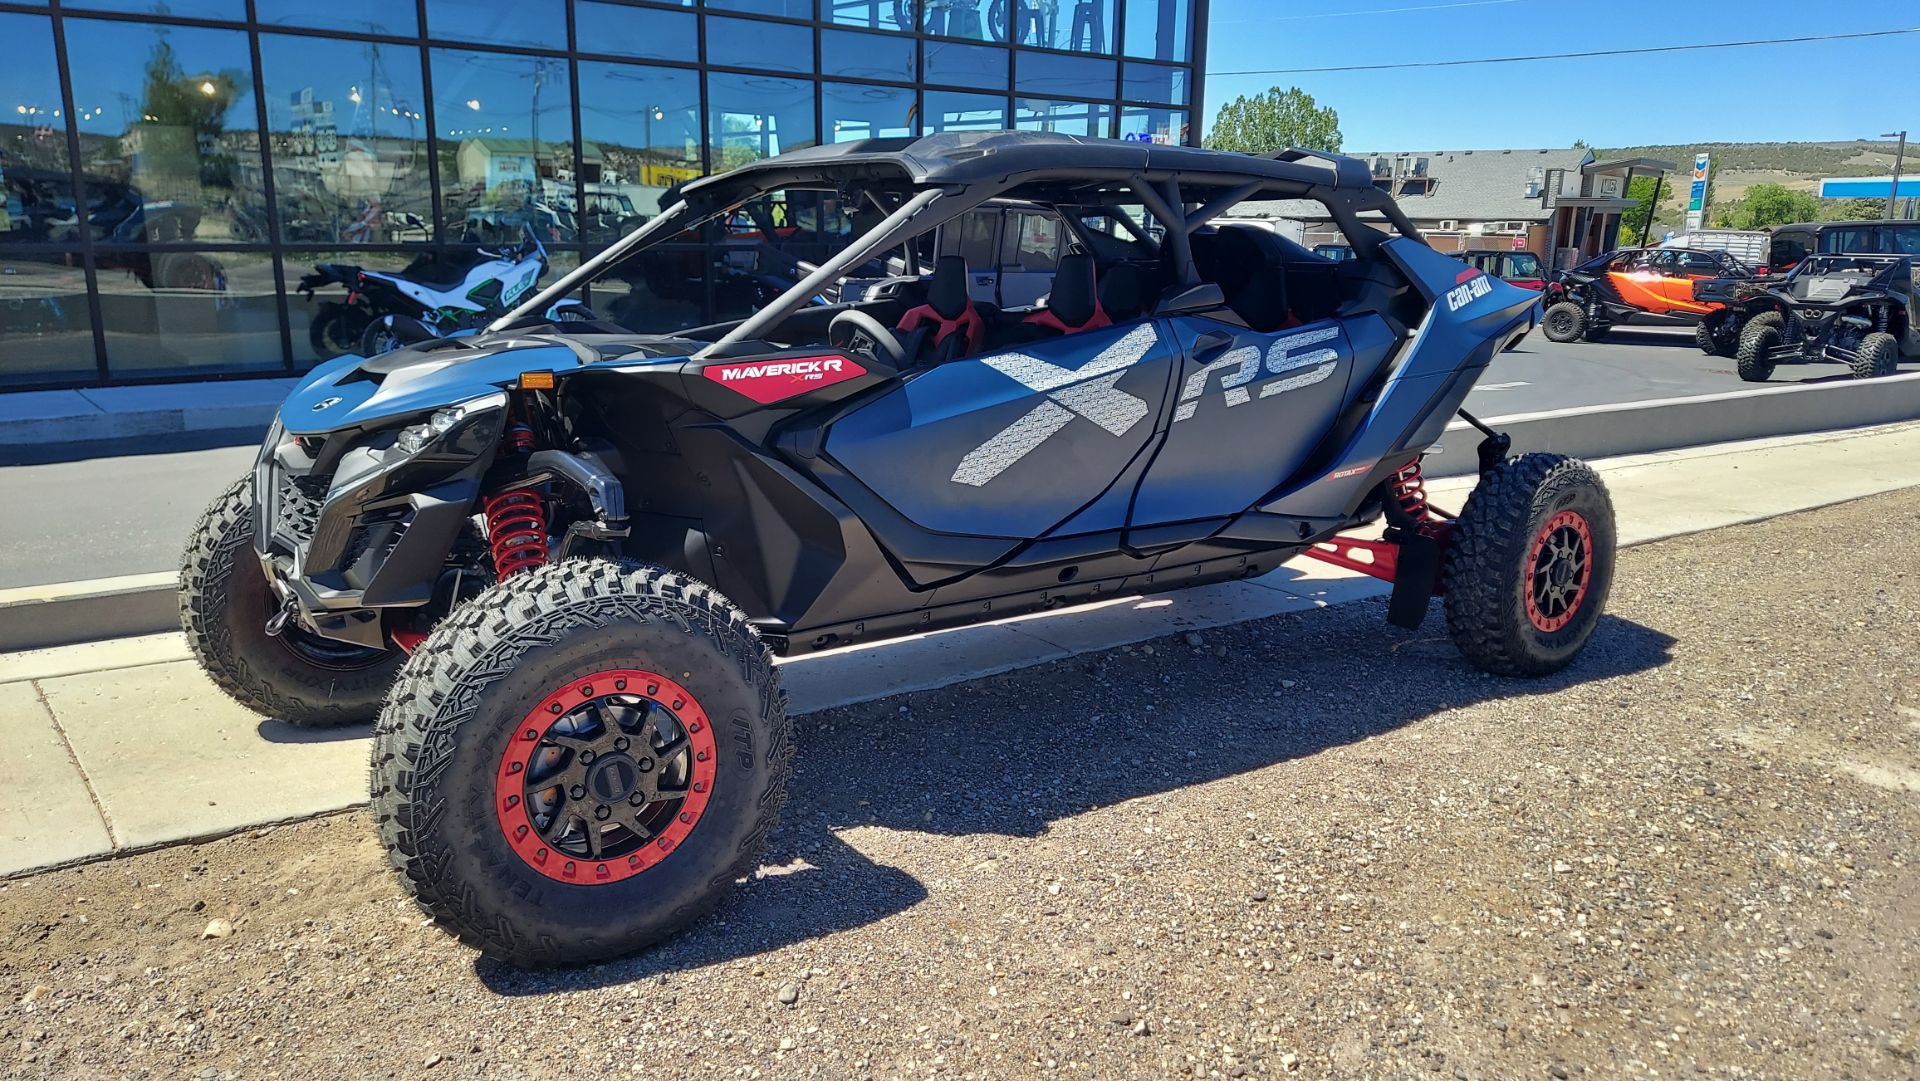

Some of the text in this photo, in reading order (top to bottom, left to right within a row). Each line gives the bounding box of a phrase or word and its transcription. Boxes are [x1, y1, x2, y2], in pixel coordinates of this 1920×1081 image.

[722, 359, 843, 381] MAVERICK R
[1334, 469, 1356, 478] ROTAX
[732, 716, 755, 771] ITP
